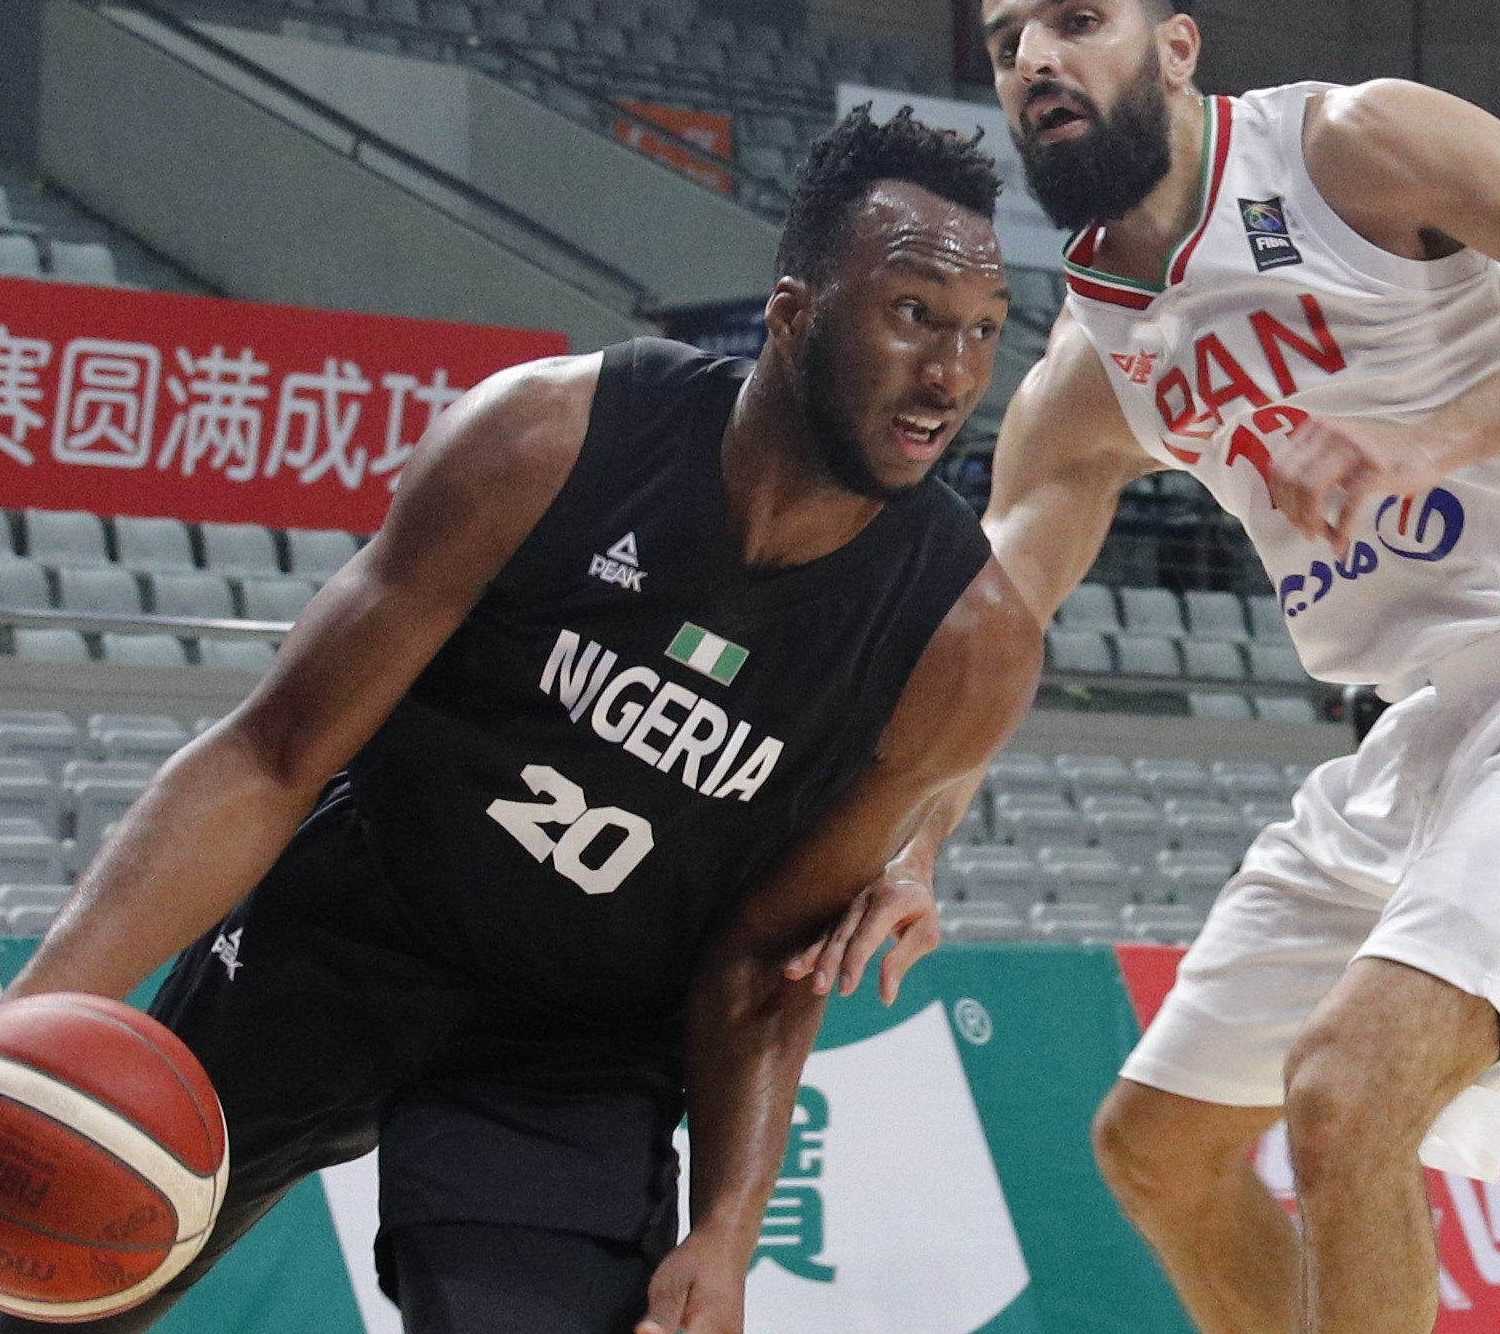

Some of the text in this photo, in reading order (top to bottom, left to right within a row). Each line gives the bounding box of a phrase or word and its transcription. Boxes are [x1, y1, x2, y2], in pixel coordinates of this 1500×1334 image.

[1255, 236, 1290, 252] FIBA
[588, 553, 648, 593] PEAK
[538, 628, 785, 803] NIGERIA
[485, 763, 656, 896] 20
